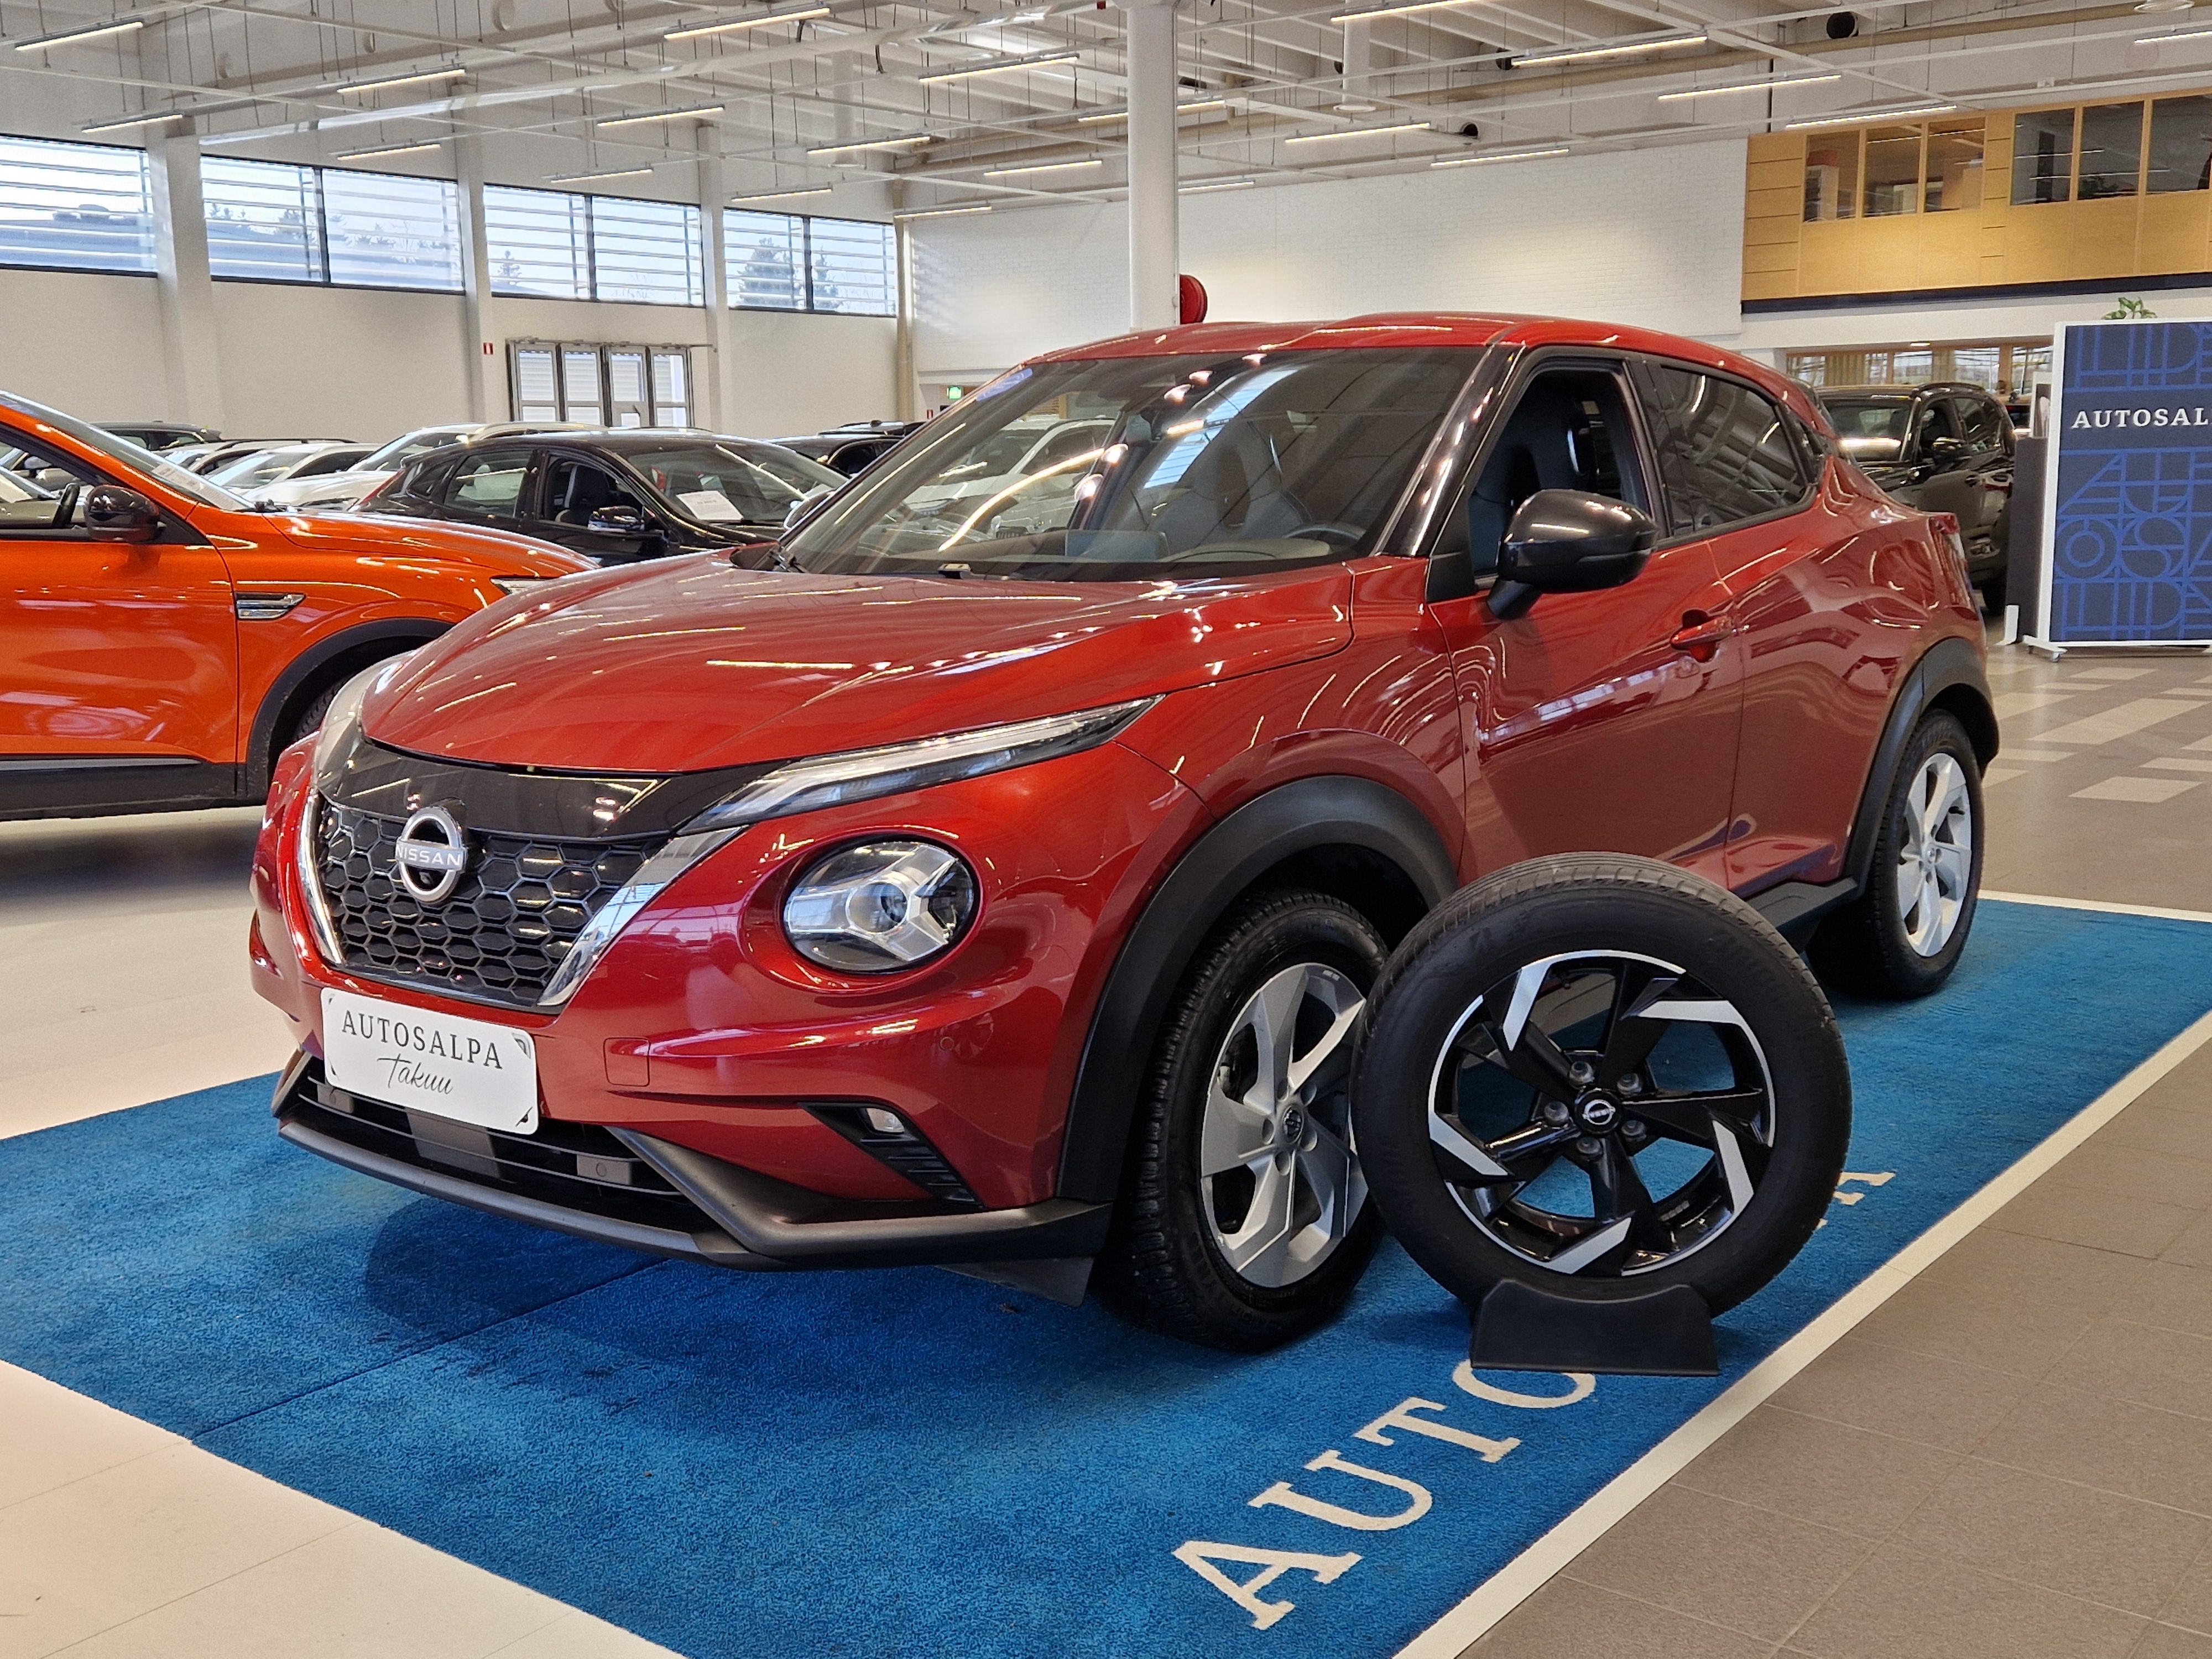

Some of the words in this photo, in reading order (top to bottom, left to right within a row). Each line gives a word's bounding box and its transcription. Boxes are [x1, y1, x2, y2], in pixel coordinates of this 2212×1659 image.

[2070, 407, 2212, 429] AUTOSAL
[396, 842, 461, 866] NISSAN
[342, 1010, 503, 1070] AUTOSALPA
[377, 1053, 453, 1094] Takuu
